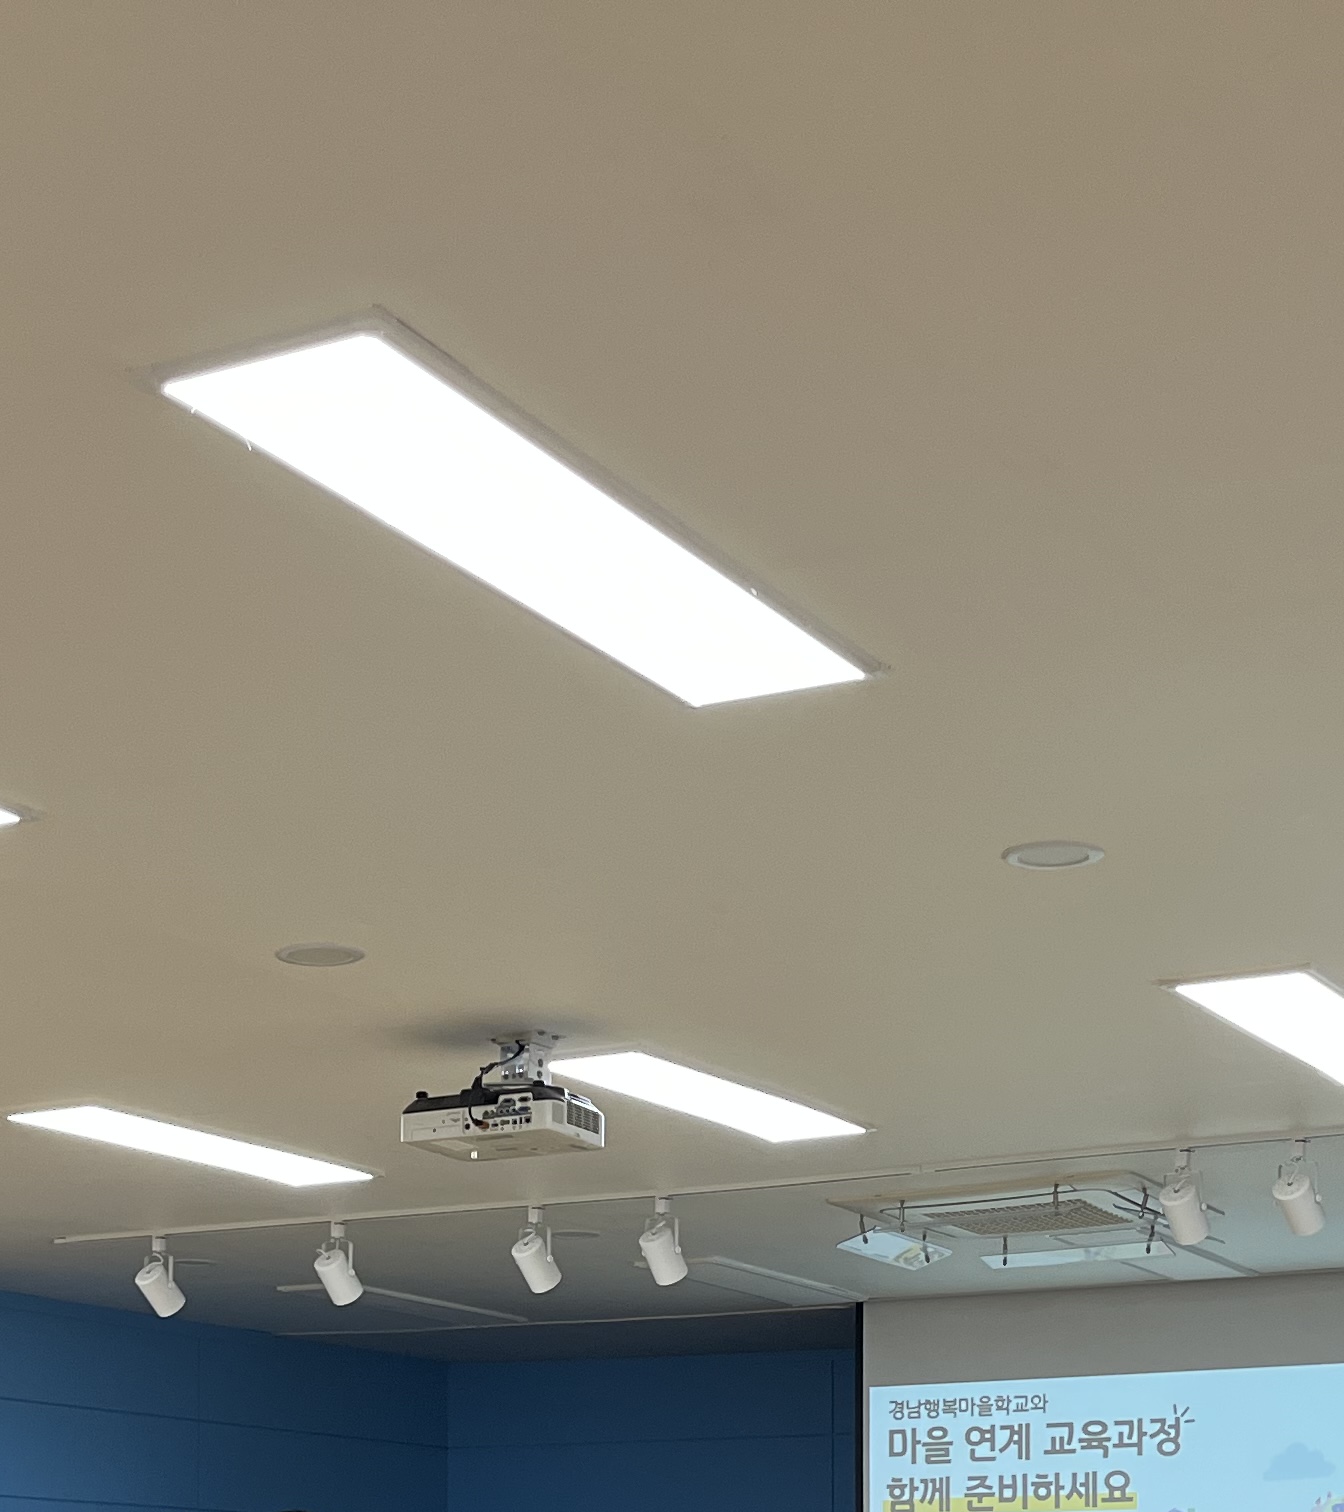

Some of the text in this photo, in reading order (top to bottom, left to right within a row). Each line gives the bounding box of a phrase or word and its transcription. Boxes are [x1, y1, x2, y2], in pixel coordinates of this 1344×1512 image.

[889, 1394, 1048, 1420] 경남행복마을학교와
[889, 1416, 1182, 1465] 마을 연계 교육과정
[963, 1470, 1134, 1512] 준비하세요
